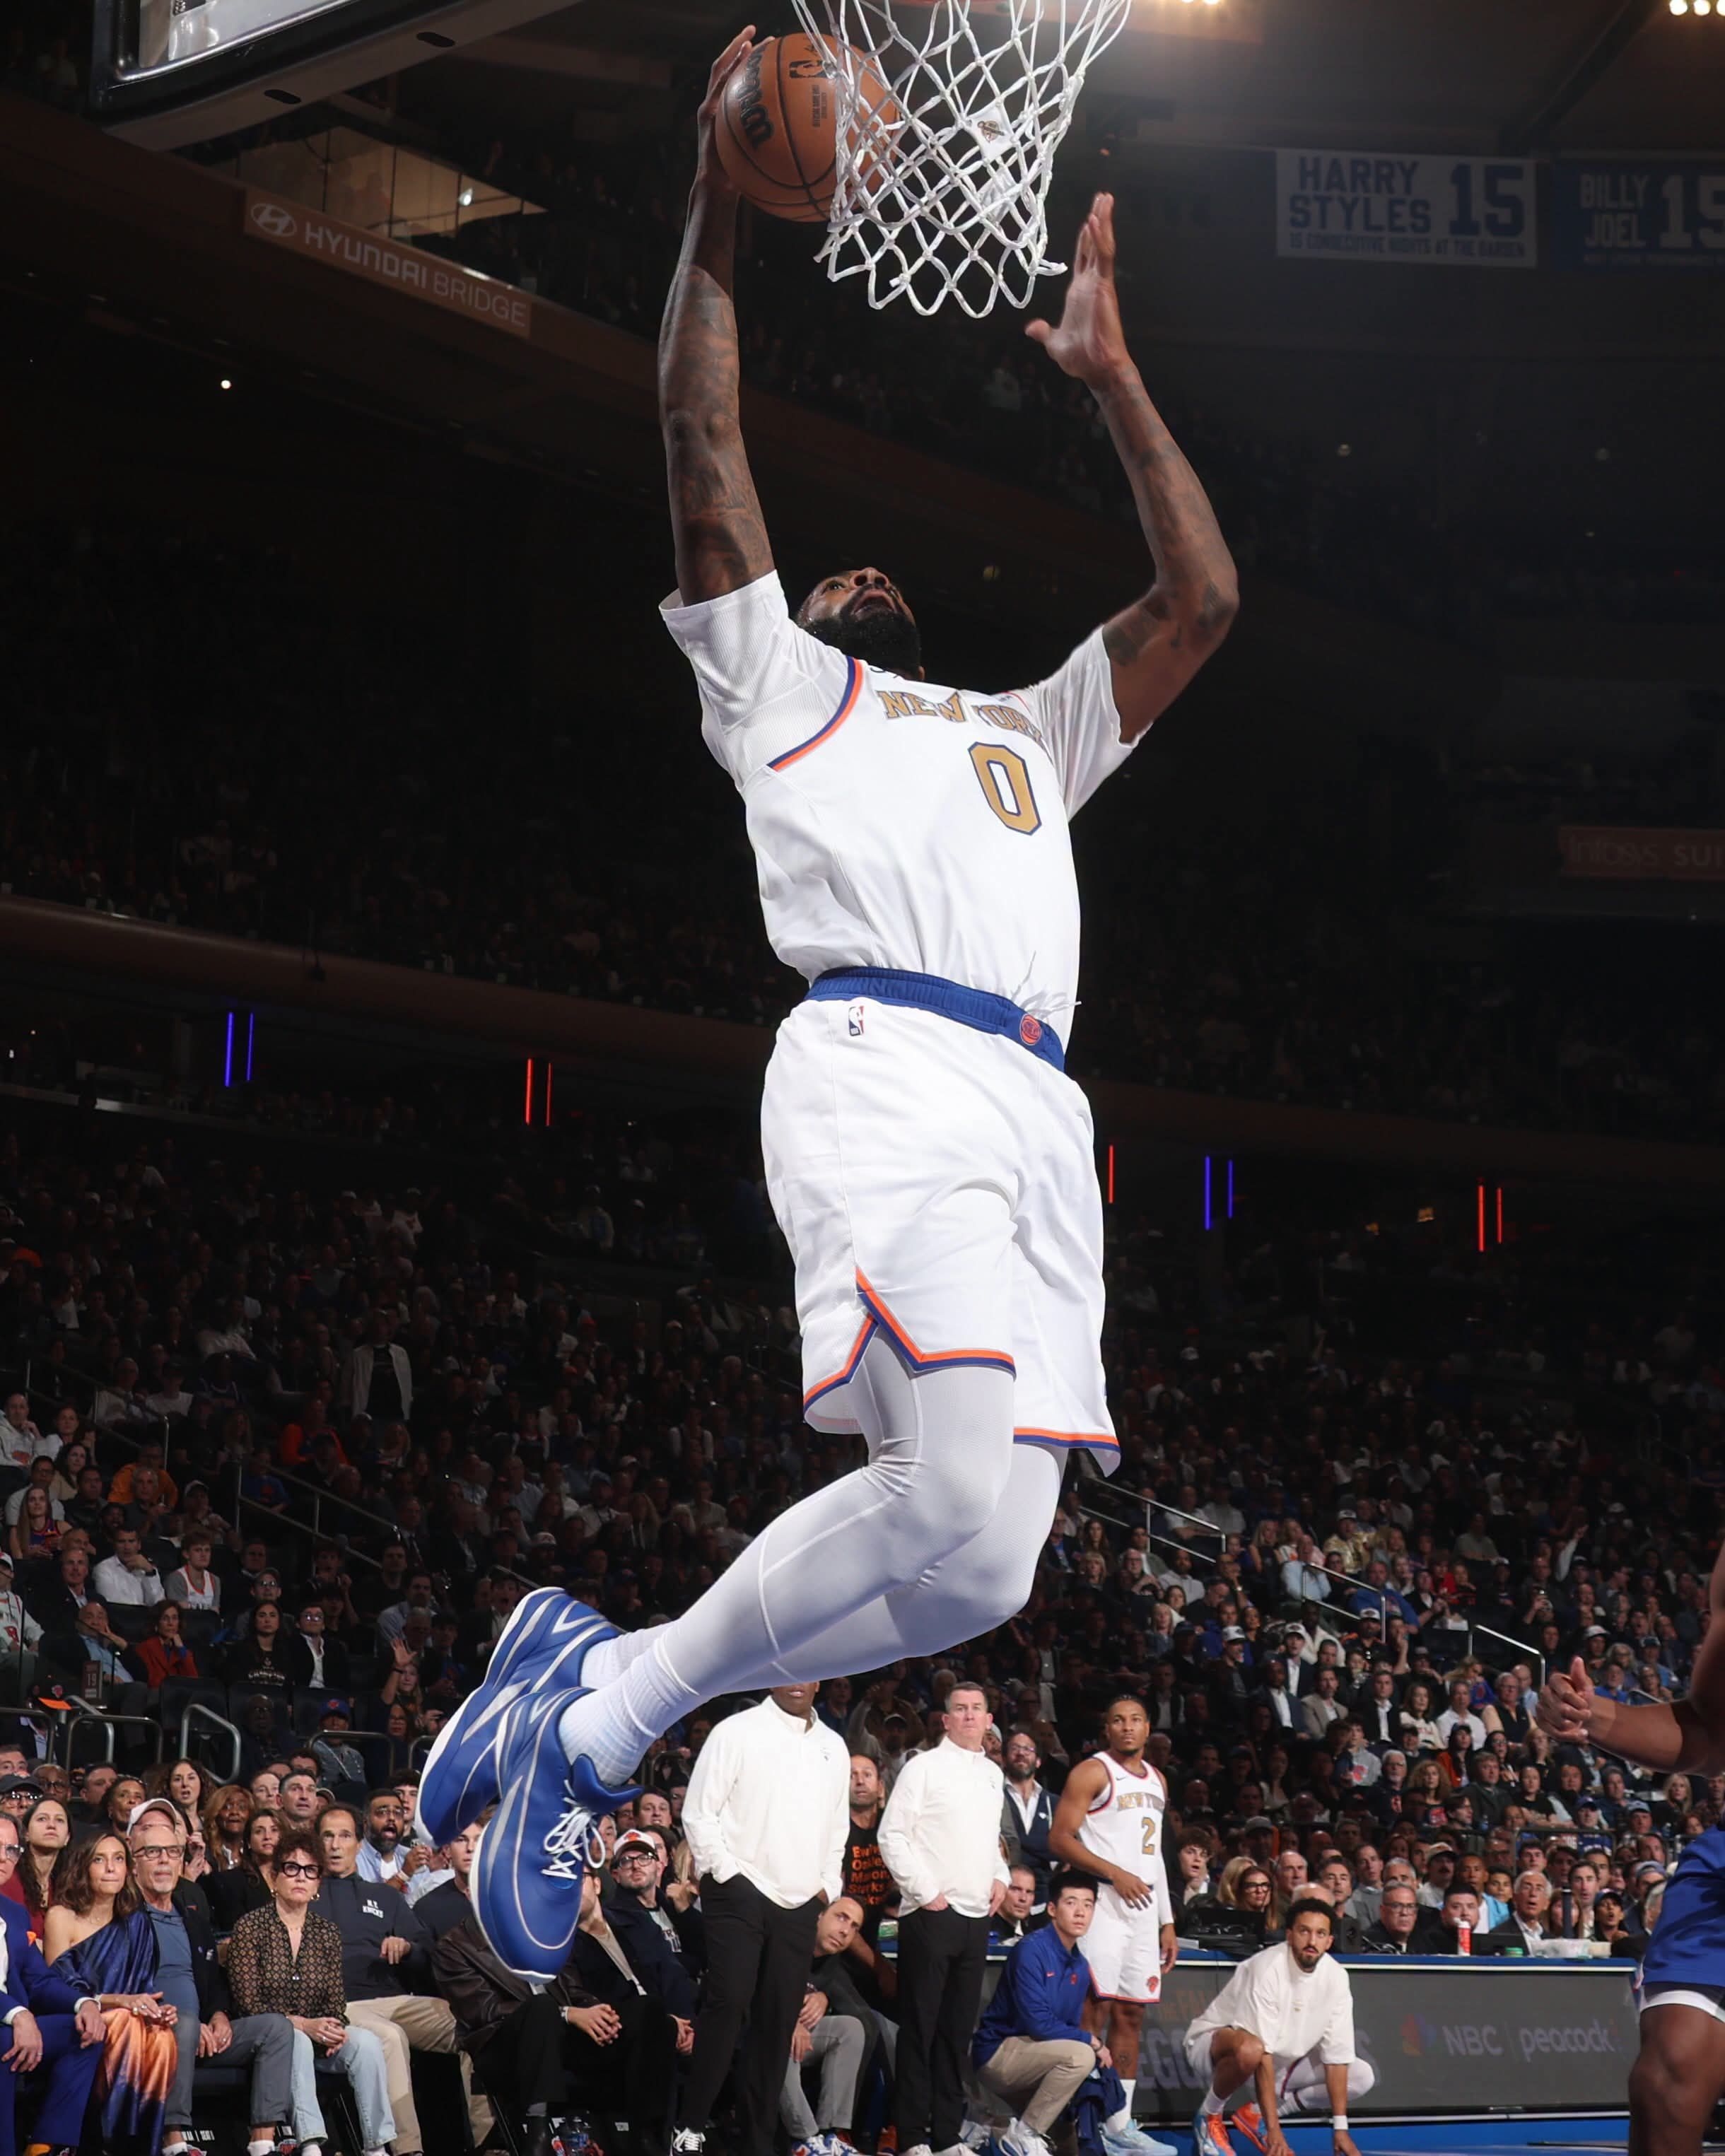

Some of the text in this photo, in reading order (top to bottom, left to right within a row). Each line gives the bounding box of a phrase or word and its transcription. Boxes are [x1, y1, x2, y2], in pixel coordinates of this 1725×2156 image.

[1298, 156, 1420, 195] HARRY
[1580, 173, 1650, 210] BILLY
[1289, 193, 1431, 235] STYLES
[1449, 163, 1525, 237] 15
[1583, 213, 1647, 249] JOEL
[305, 221, 527, 327] HYUNDAI BRIDGE
[875, 689, 1046, 751] NEW ORK
[967, 741, 1042, 836] 0
[1141, 1816, 1156, 1856] 2
[1442, 2017, 1615, 2063] NBC peacock
